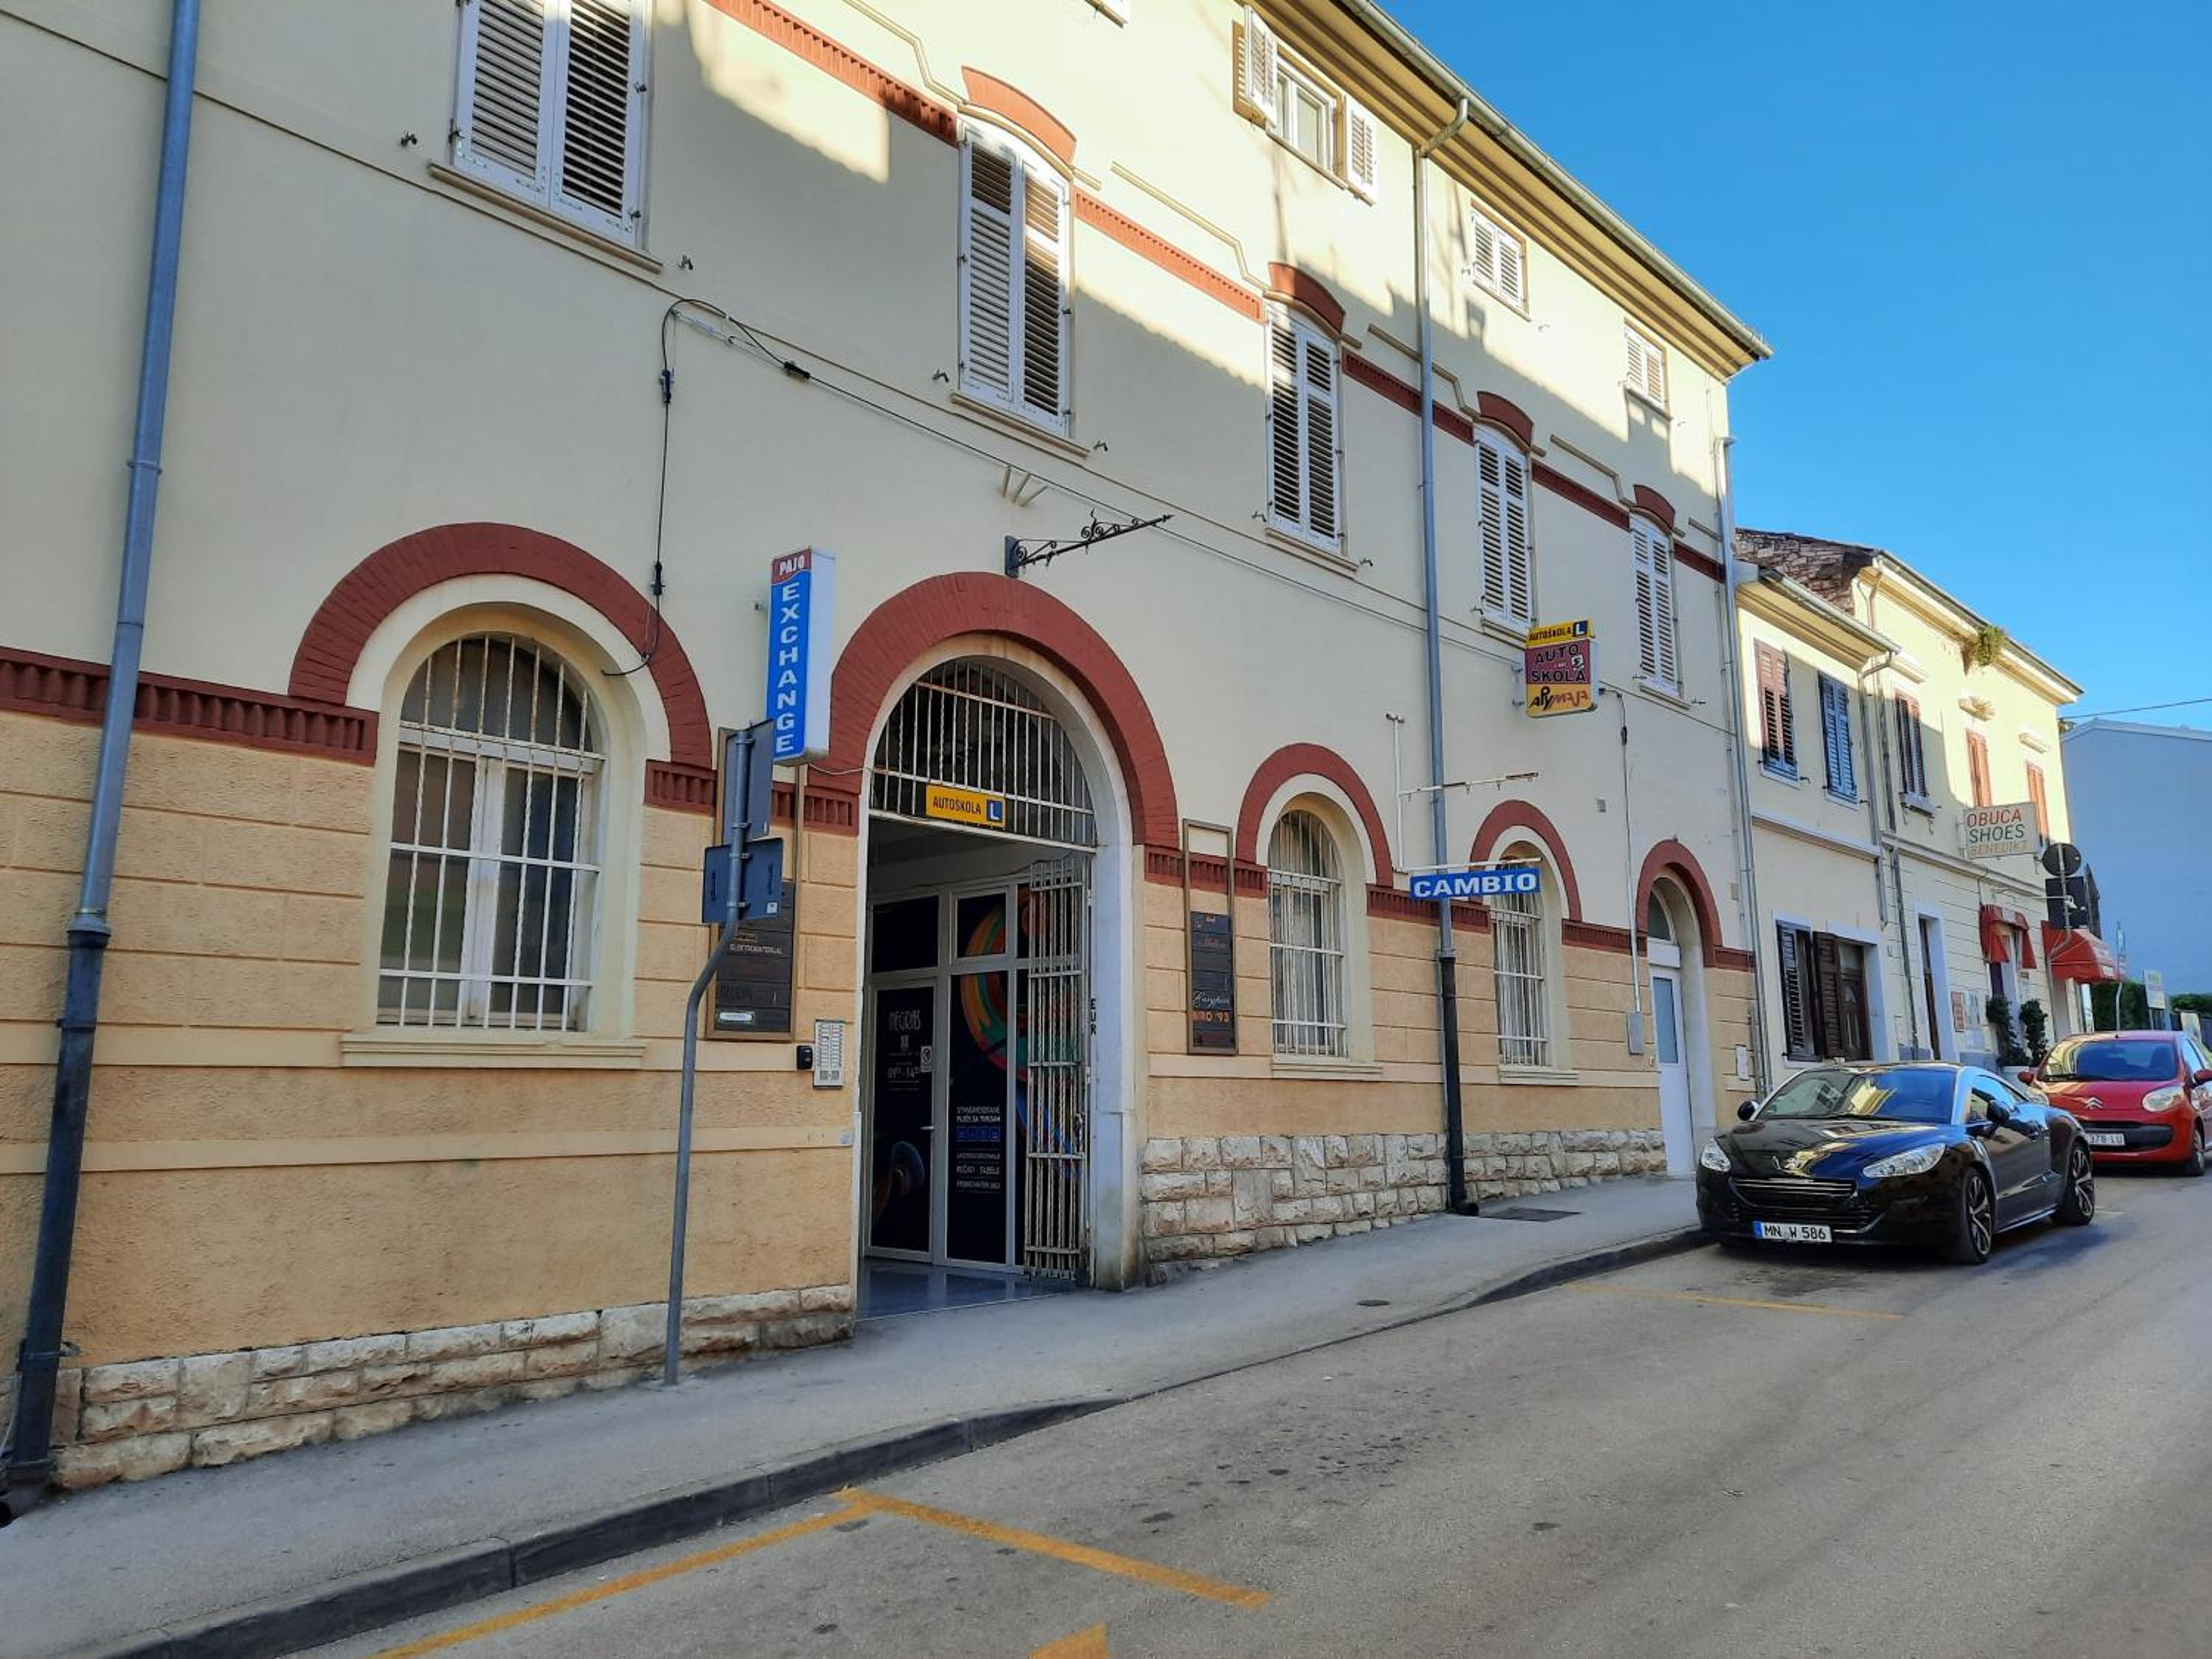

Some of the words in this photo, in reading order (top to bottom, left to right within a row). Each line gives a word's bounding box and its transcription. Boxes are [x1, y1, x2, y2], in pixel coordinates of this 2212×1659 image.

[779, 554, 805, 576] PAJO
[1534, 643, 1579, 665] AUTO
[775, 581, 801, 753] EXCHANGE
[990, 801, 1000, 821] L
[1969, 824, 2025, 844] SHOES
[1413, 872, 1537, 898] CAMBIO
[1764, 1225, 1782, 1237] MN
[1789, 1226, 1797, 1239] W
[1801, 1226, 1826, 1240] 586
